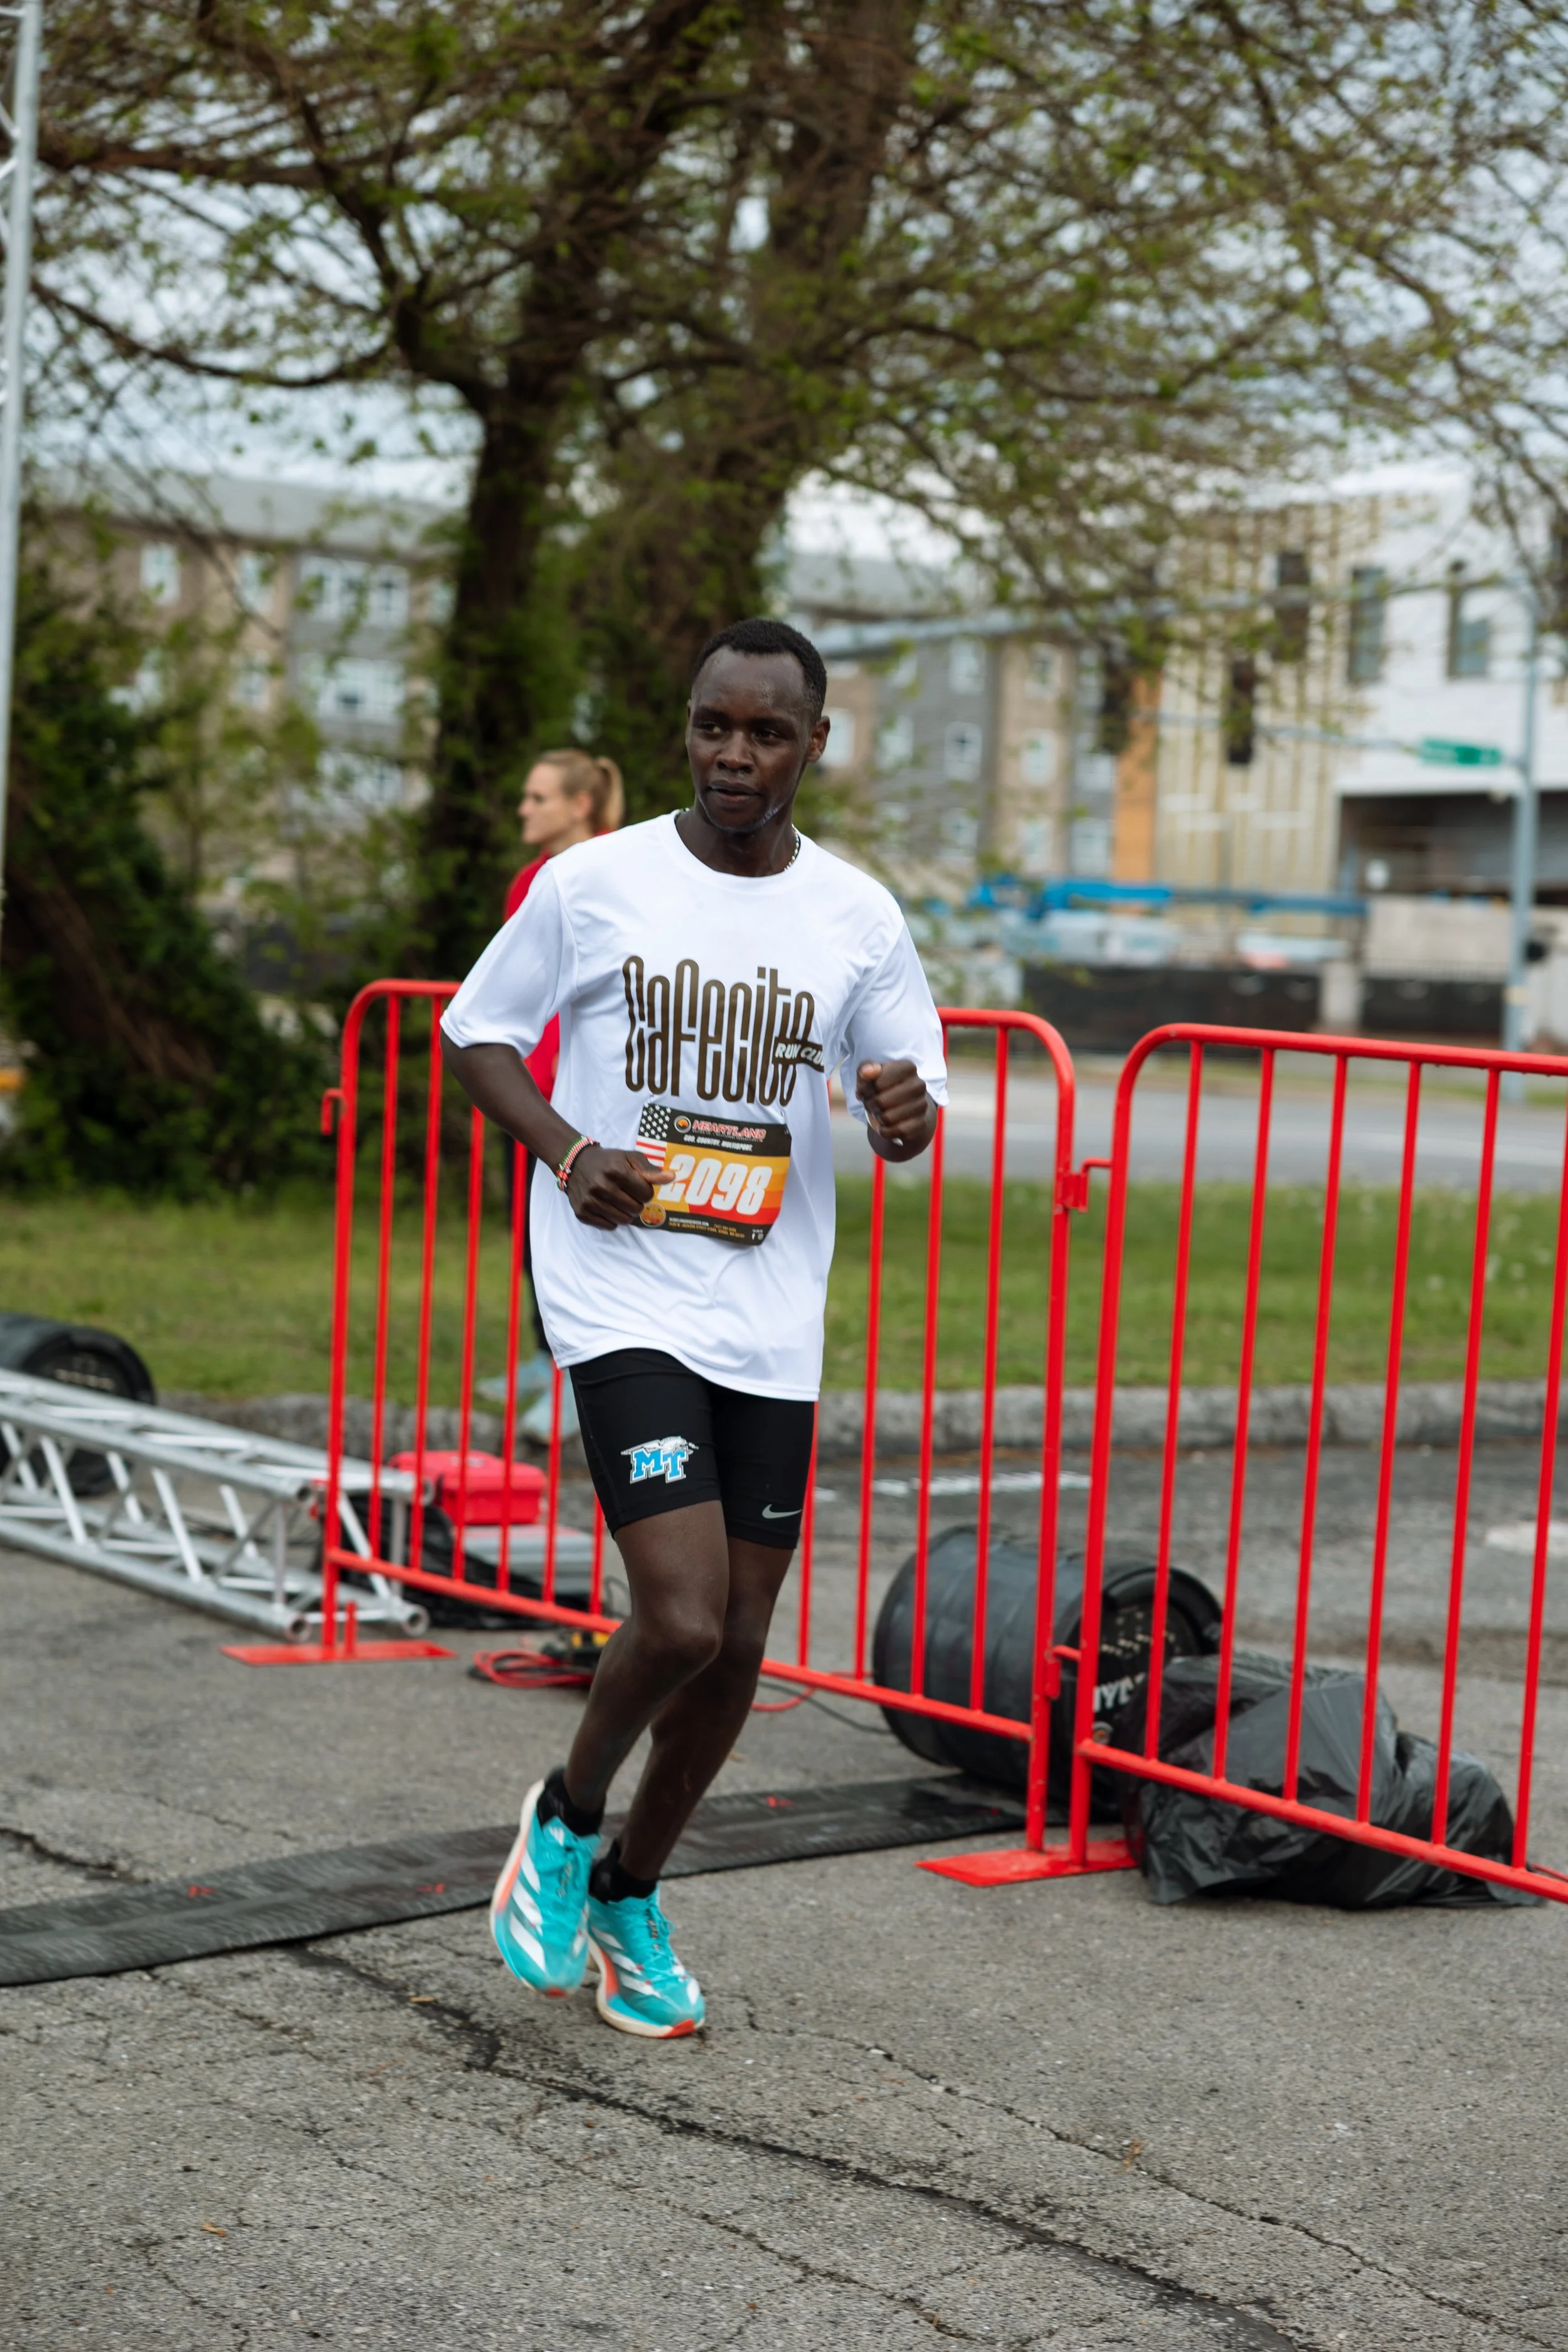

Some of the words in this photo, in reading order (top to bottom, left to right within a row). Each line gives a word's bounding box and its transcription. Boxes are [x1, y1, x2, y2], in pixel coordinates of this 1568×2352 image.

[775, 1042, 802, 1059] RUN
[800, 1047, 824, 1066] CLU
[692, 1120, 766, 1140] HEARTLAND
[657, 1154, 773, 1216] 2098
[630, 1448, 689, 1484] MT
